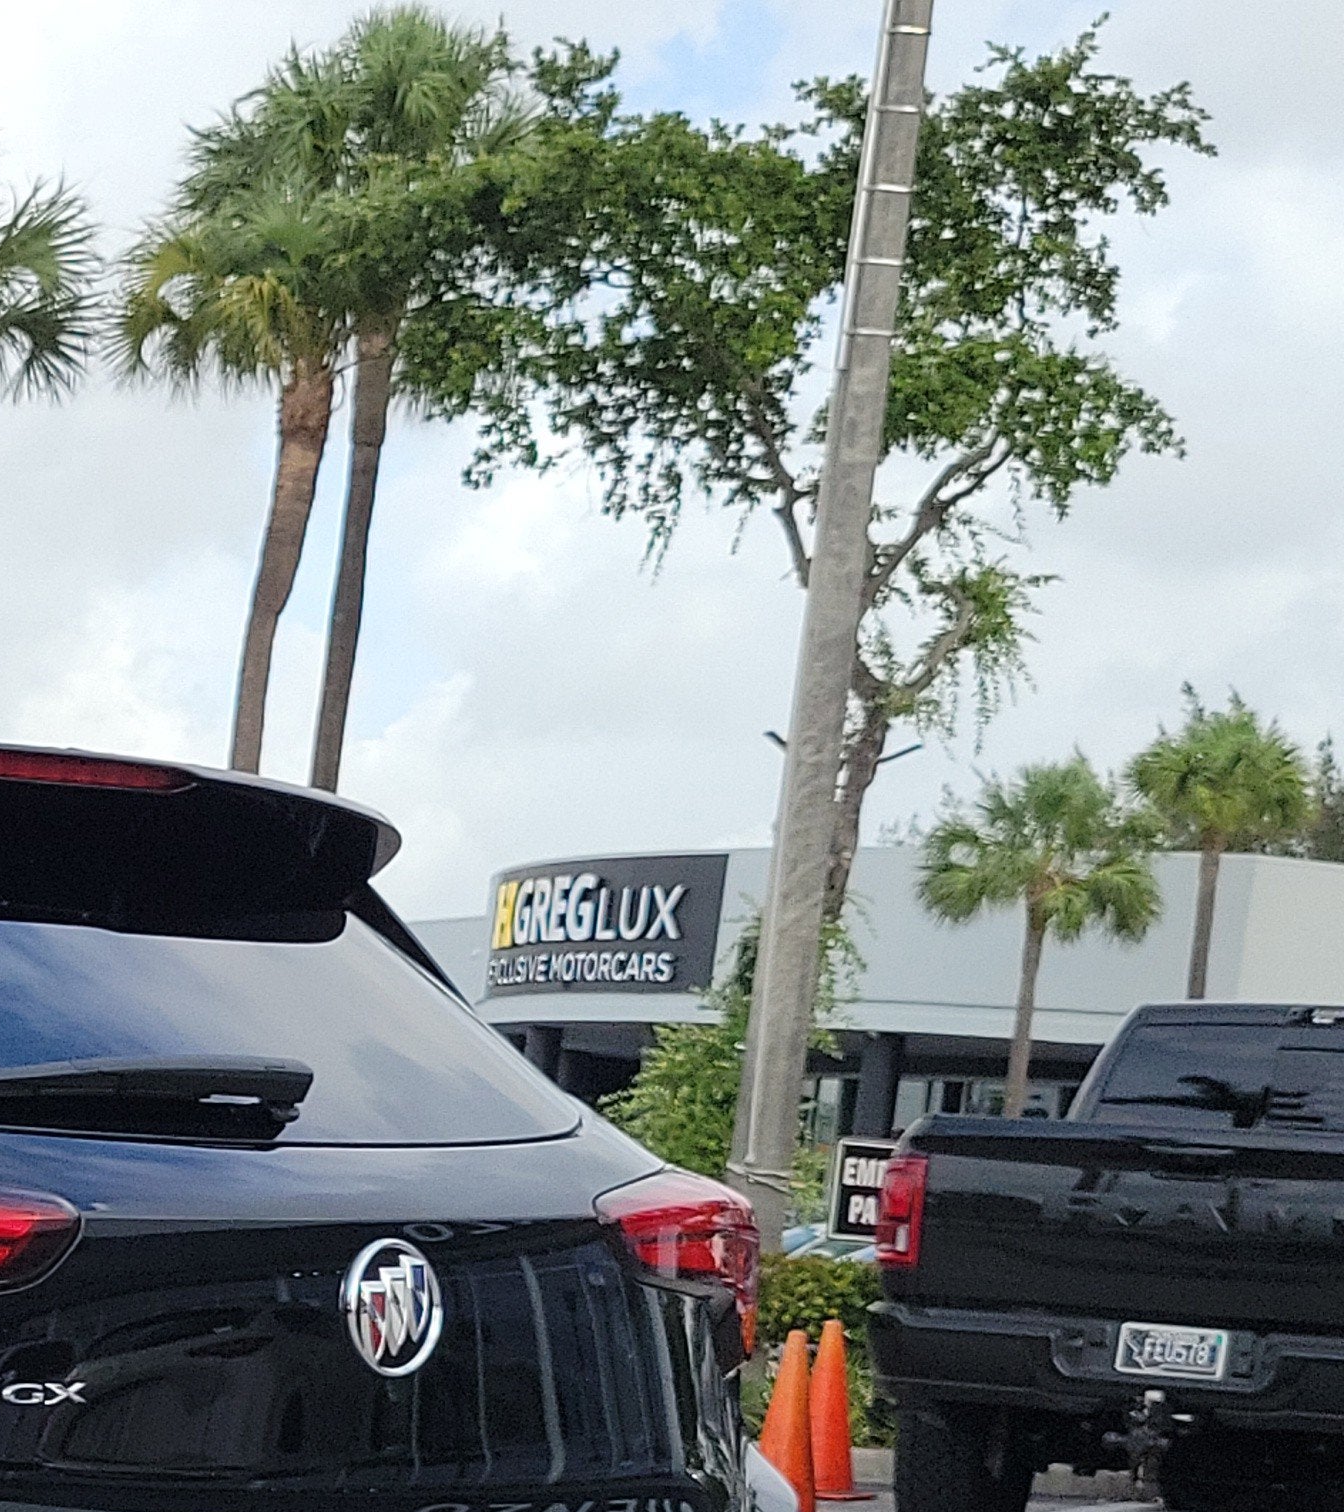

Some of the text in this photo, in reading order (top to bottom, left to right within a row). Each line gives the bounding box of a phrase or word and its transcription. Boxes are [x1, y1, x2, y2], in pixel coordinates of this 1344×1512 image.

[549, 952, 675, 983] MOTORCARS
[847, 1194, 880, 1226] PA
[1, 1381, 87, 1406] GX
